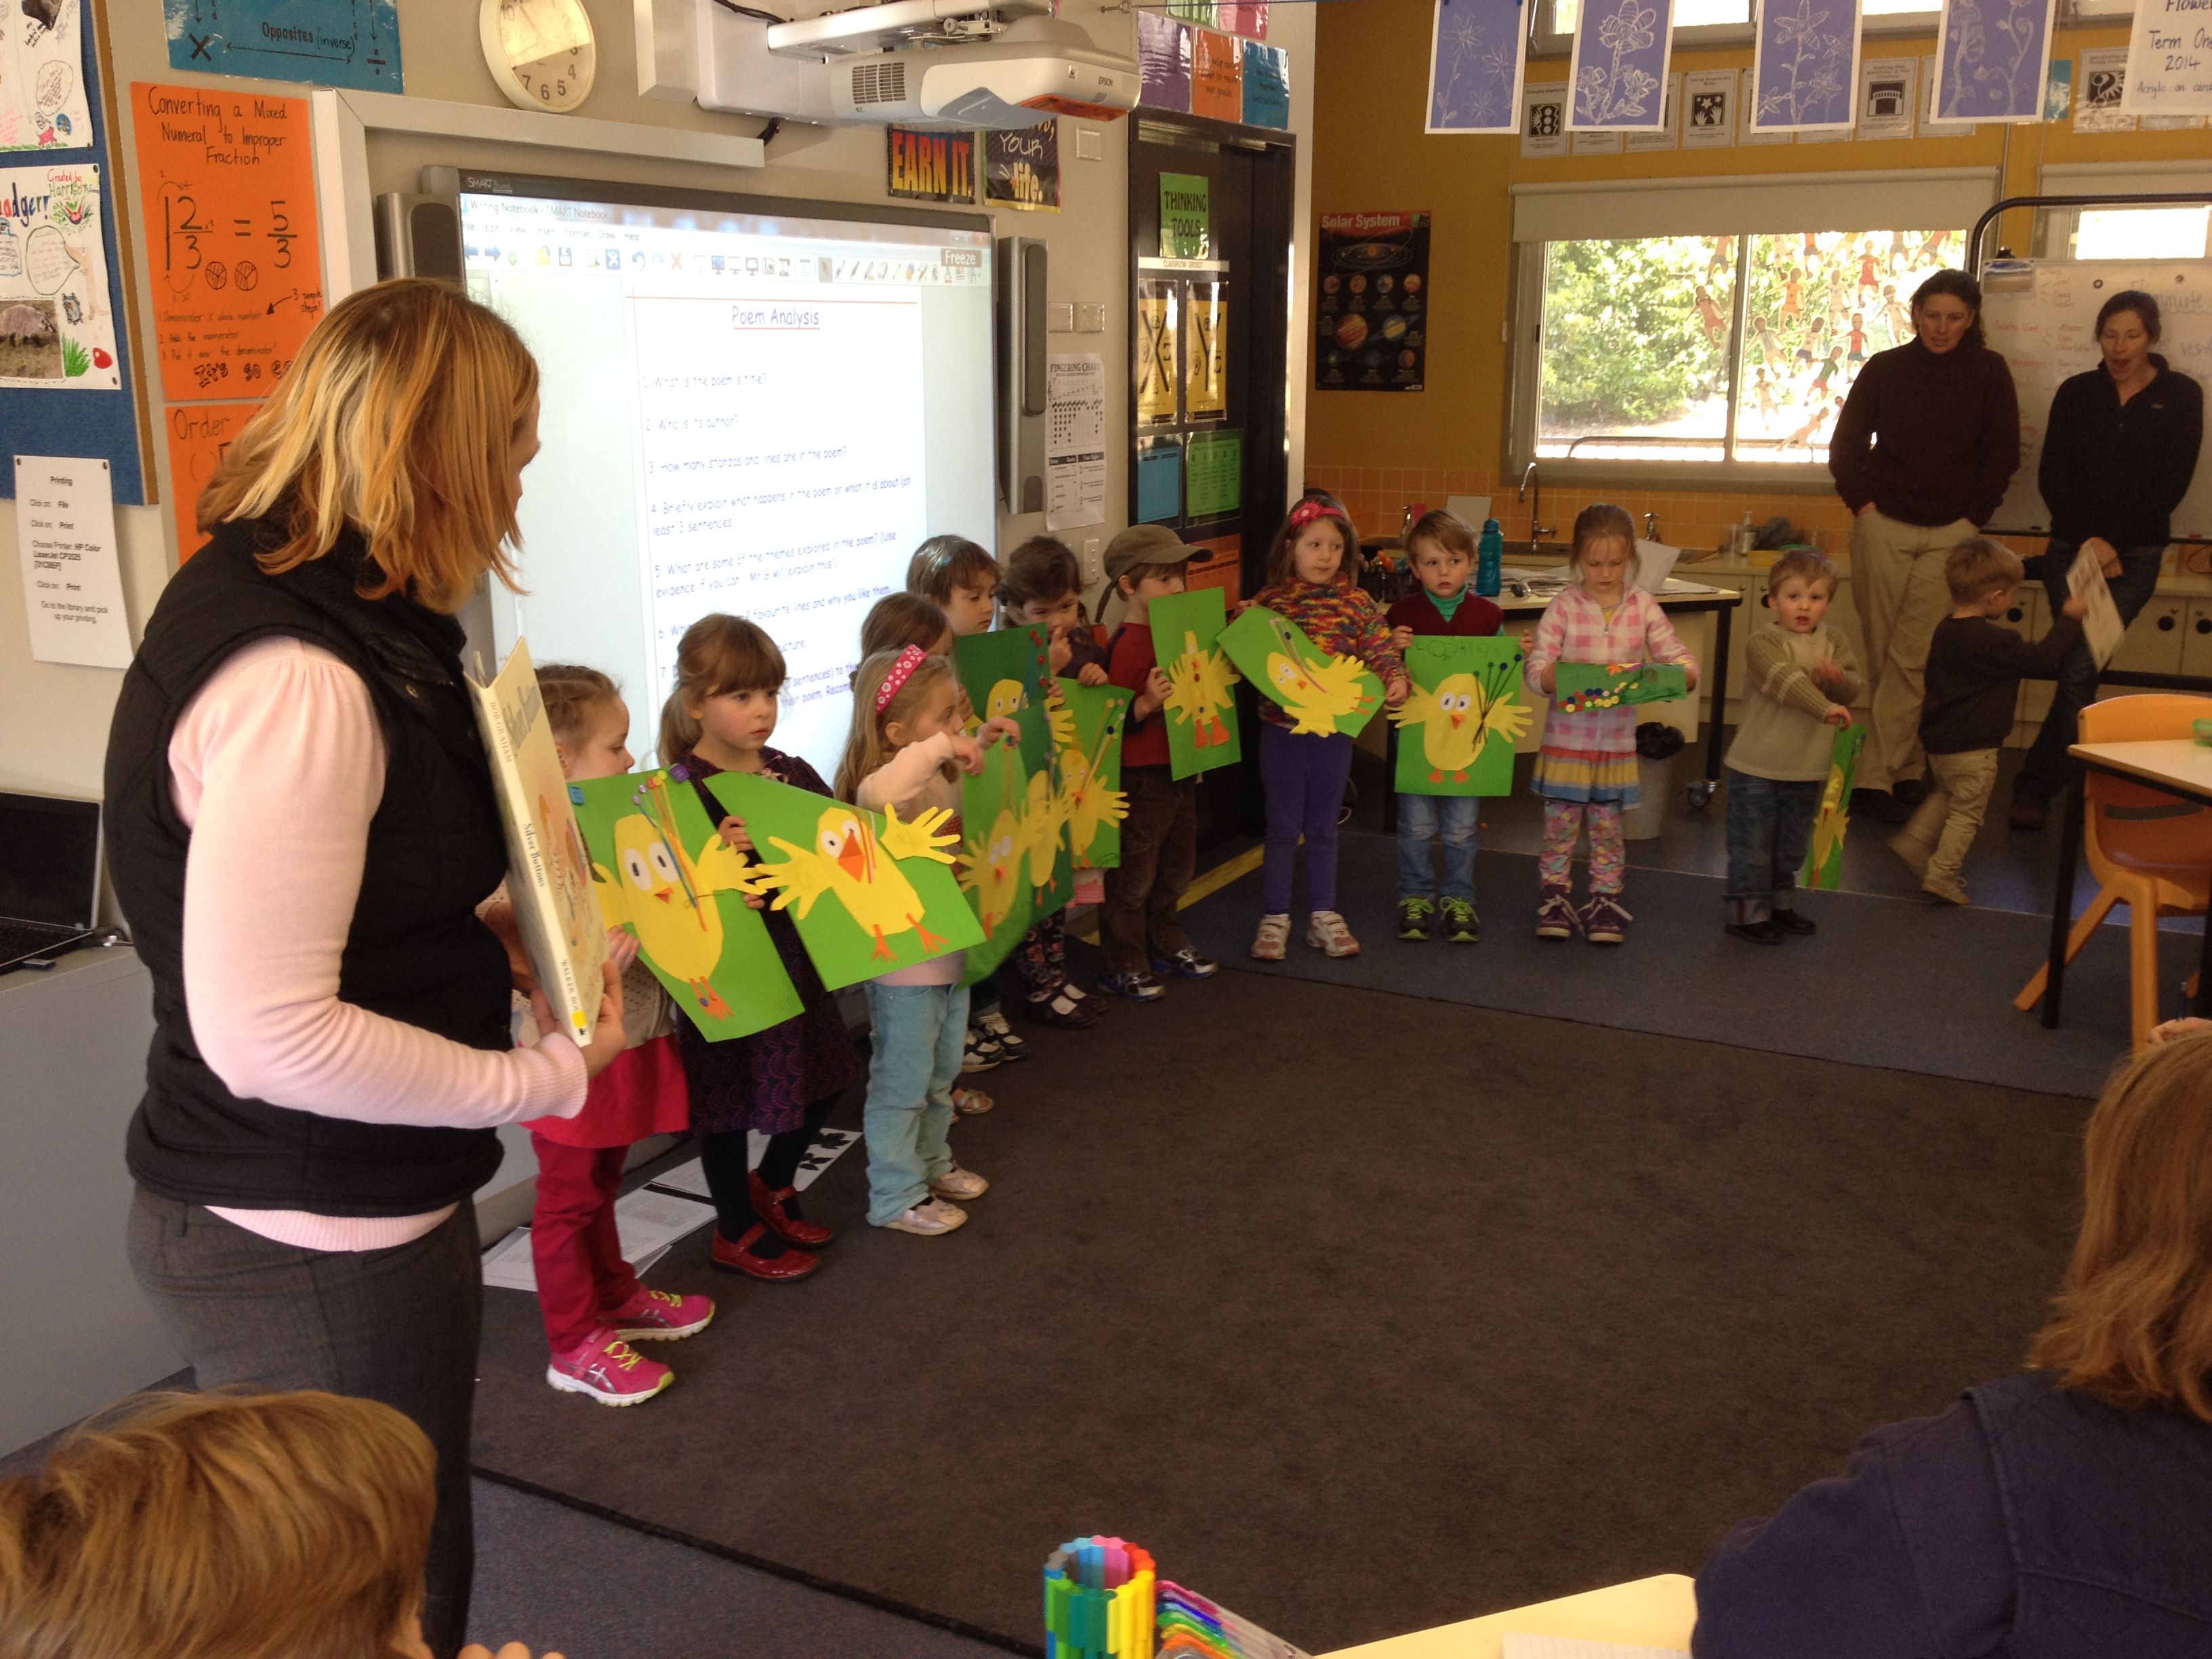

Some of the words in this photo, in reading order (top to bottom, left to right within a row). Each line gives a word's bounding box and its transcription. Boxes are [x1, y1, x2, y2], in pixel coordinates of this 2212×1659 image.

[262, 22, 314, 43] Opposites
[316, 28, 355, 56] (inverse)
[2149, 29, 2181, 49] Term
[567, 64, 577, 80] 4
[2165, 55, 2200, 71] 2014
[522, 75, 531, 90] 7
[557, 80, 567, 96] 5
[1098, 77, 1113, 87] EPSON
[541, 84, 550, 100] 6
[148, 86, 222, 133] Converting
[233, 106, 243, 118] a
[254, 100, 287, 119] Mixed
[161, 122, 207, 145] Numeral
[223, 125, 233, 144] to
[243, 127, 287, 155] Improper
[1000, 133, 1044, 159] YOUR
[206, 146, 260, 165] Fraction
[891, 131, 947, 194] EARN
[47, 169, 73, 182] Created
[75, 171, 83, 187] by
[468, 177, 493, 188] SMART
[49, 182, 89, 199] Harrison
[501, 202, 539, 215] Notebook
[546, 205, 572, 217] SMART
[574, 207, 609, 220] Notebook
[1164, 190, 1207, 213] THINKING
[178, 195, 203, 230] 2
[270, 200, 289, 232] 5
[1322, 215, 1354, 228] Solar
[1355, 214, 1401, 230] System
[624, 232, 640, 242] Help
[1171, 218, 1201, 238] TOOLS
[186, 234, 202, 270] 3
[274, 238, 291, 269] 3
[945, 249, 976, 265] Freeze
[1163, 260, 1186, 268] CLASSROOM
[732, 306, 766, 325] Poem
[770, 308, 820, 330] Analysis
[1050, 363, 1081, 372] FINGERING
[173, 408, 231, 440] Order
[709, 457, 742, 469] stanzas
[808, 448, 822, 459] the
[823, 446, 847, 460] poem?
[50, 476, 73, 487] Printing
[813, 487, 833, 499] poem
[845, 482, 863, 493] what
[880, 477, 899, 489] about
[59, 522, 75, 530] Print
[856, 533, 879, 548] poem?
[880, 531, 897, 544] (Use
[827, 594, 842, 607] why
[844, 592, 857, 603] you
[858, 588, 871, 600] like
[490, 701, 500, 720] BOB
[496, 722, 512, 762] GRAHAM
[523, 823, 535, 849] Silver
[531, 851, 545, 888] Buttons
